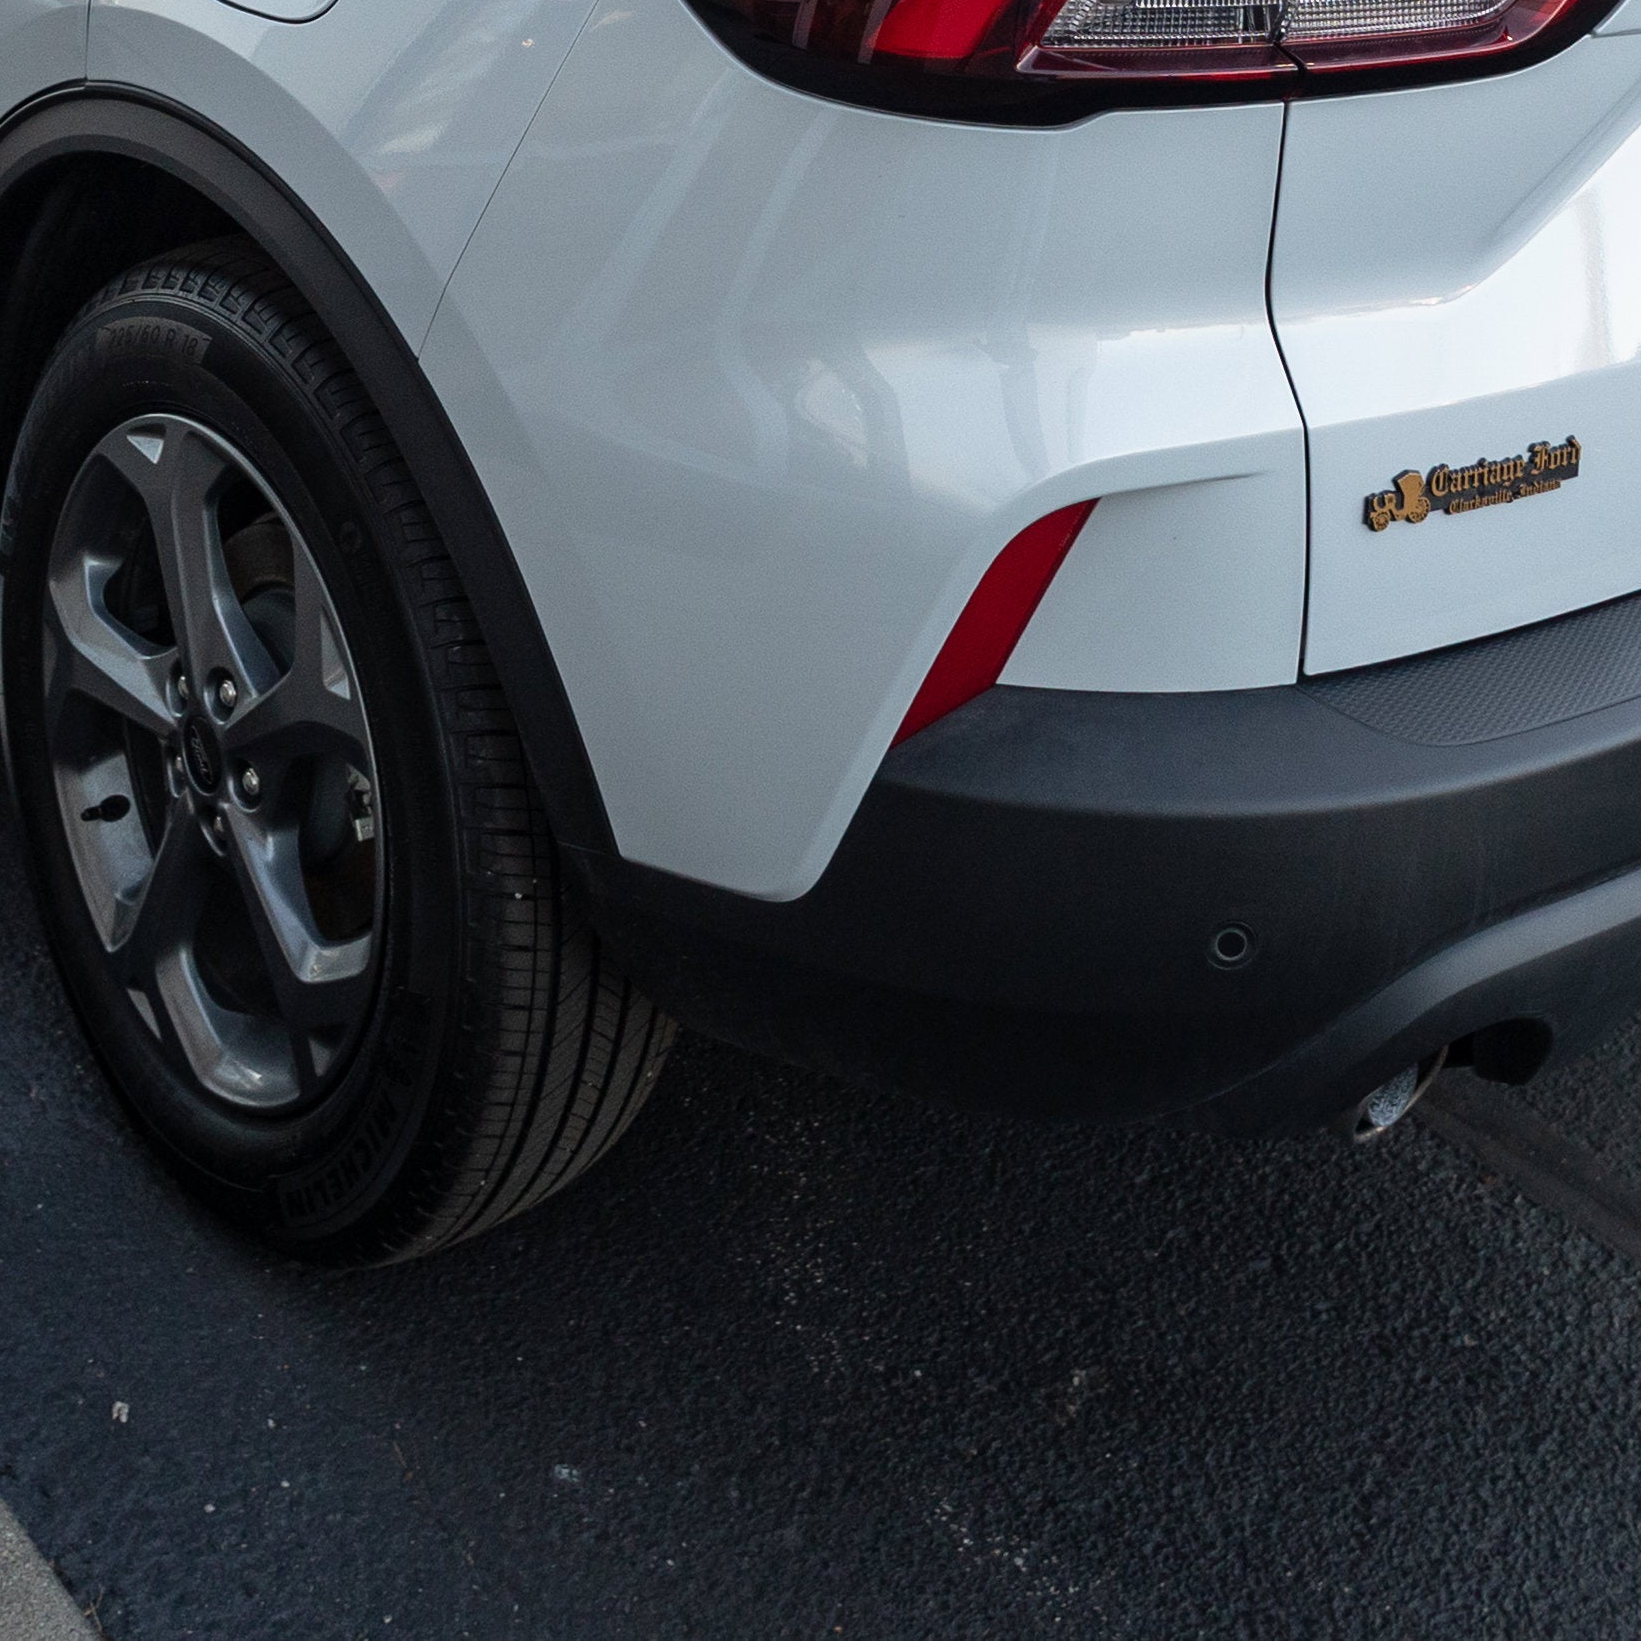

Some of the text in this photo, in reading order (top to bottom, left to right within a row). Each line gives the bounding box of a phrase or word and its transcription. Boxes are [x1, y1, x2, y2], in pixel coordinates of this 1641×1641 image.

[1430, 435, 1582, 497] Carriage Ford
[285, 1089, 398, 1217] MICHELIN
